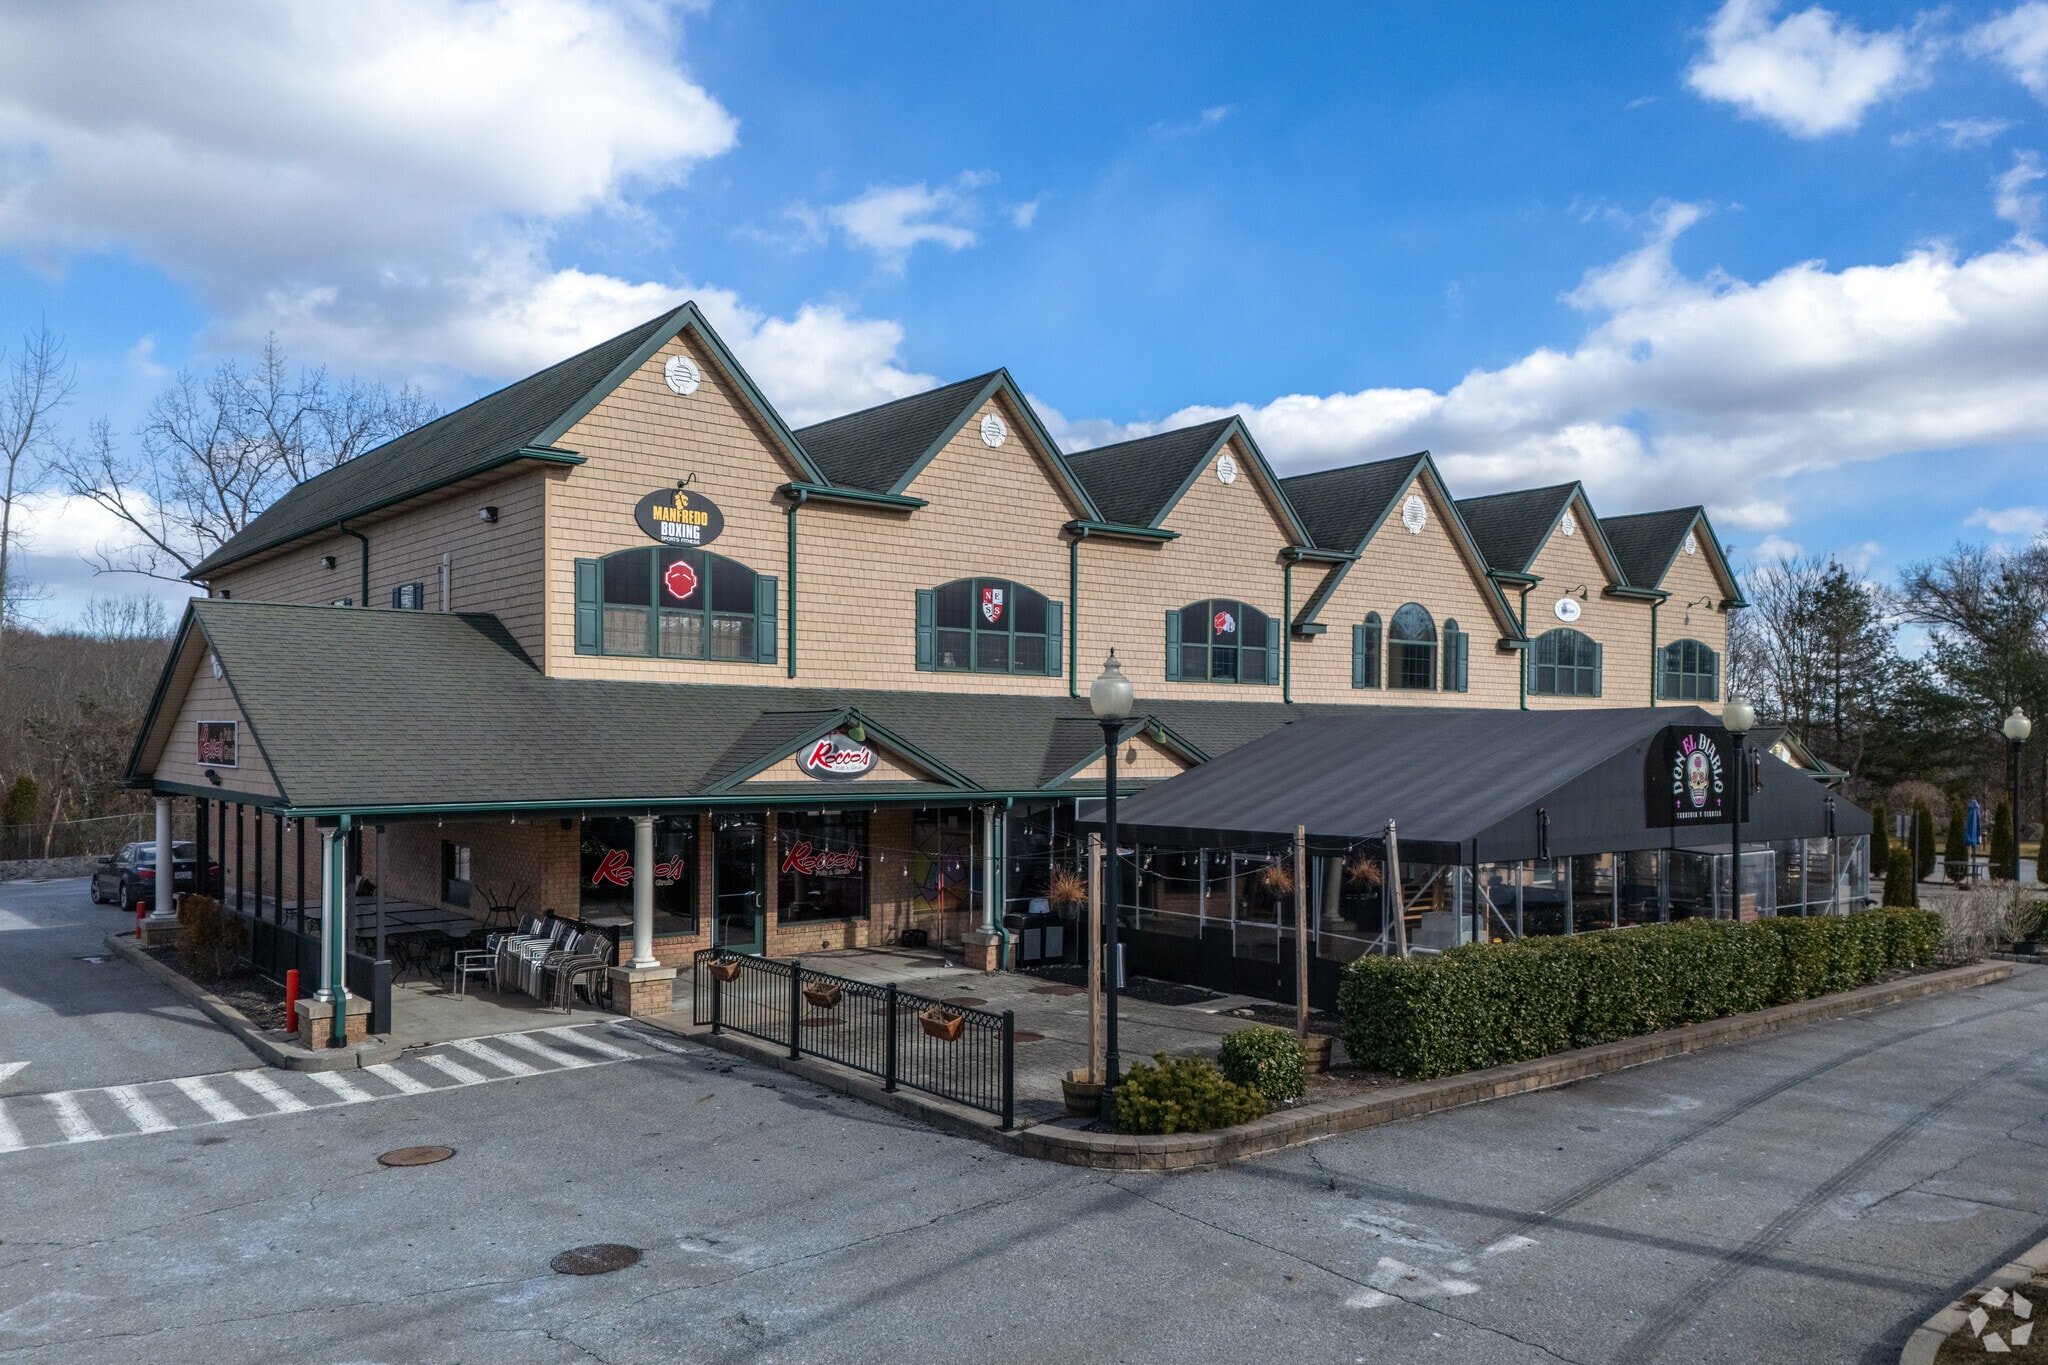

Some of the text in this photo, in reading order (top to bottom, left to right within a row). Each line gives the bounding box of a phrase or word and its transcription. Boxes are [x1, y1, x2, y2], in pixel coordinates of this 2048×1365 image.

[653, 506, 708, 526] MANFREDO
[661, 521, 700, 540] BOXING
[808, 740, 871, 769] Rocco's
[1673, 733, 1724, 795] DON EL DIABLO
[592, 849, 684, 886] Roo's
[782, 840, 859, 875] Rocco's
